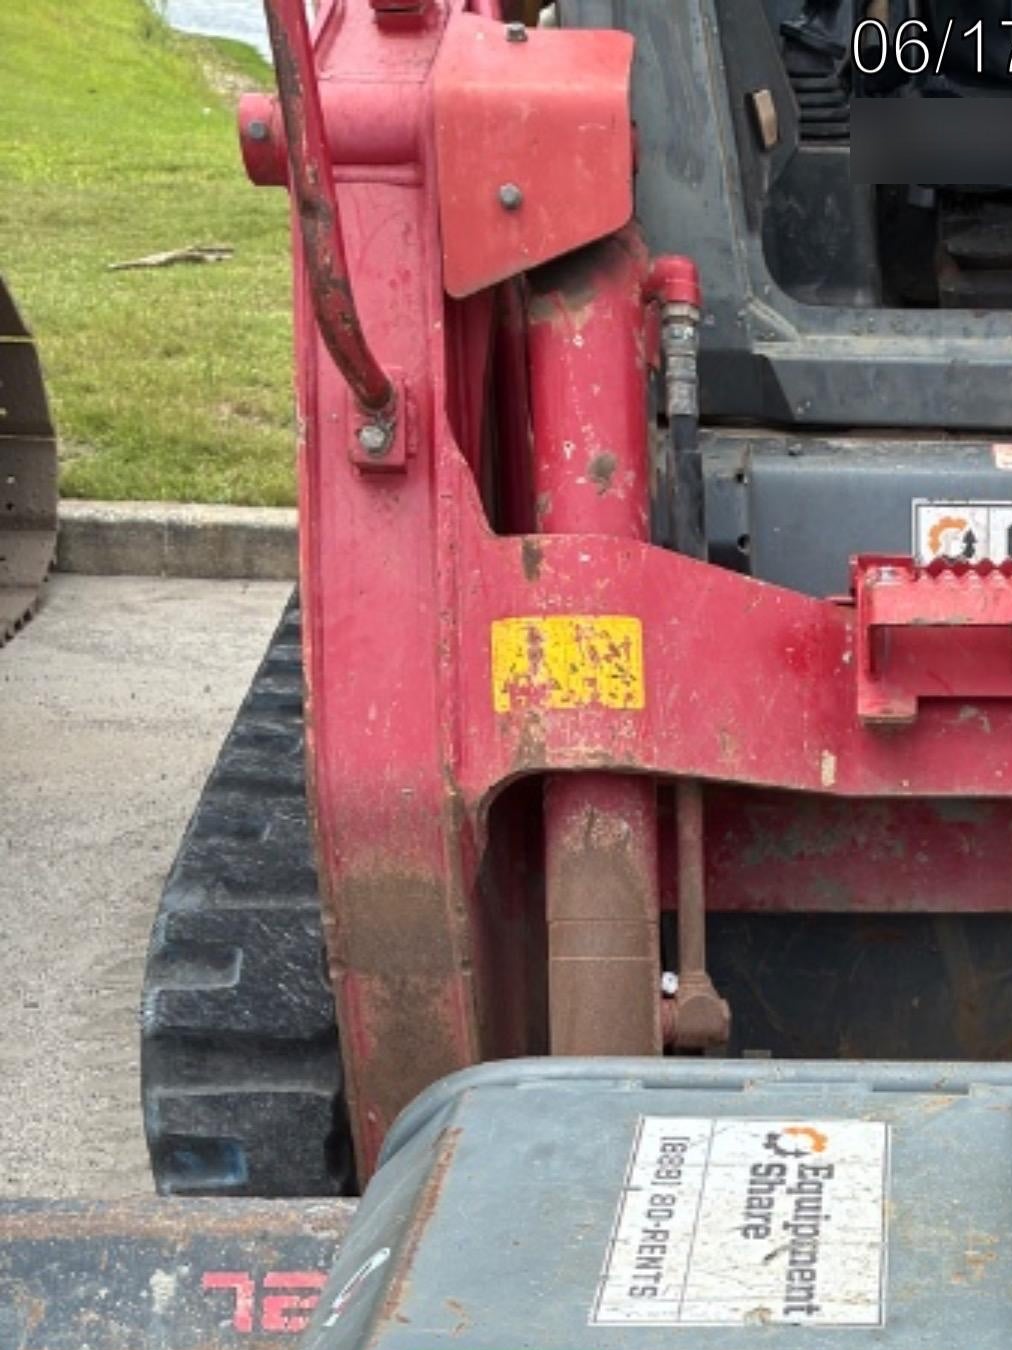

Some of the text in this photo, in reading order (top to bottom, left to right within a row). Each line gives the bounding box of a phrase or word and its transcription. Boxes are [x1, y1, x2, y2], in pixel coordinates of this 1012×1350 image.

[626, 1135, 691, 1299] (888) 80-RENTS
[741, 1162, 787, 1240] Share
[783, 1162, 835, 1317] Equipment
